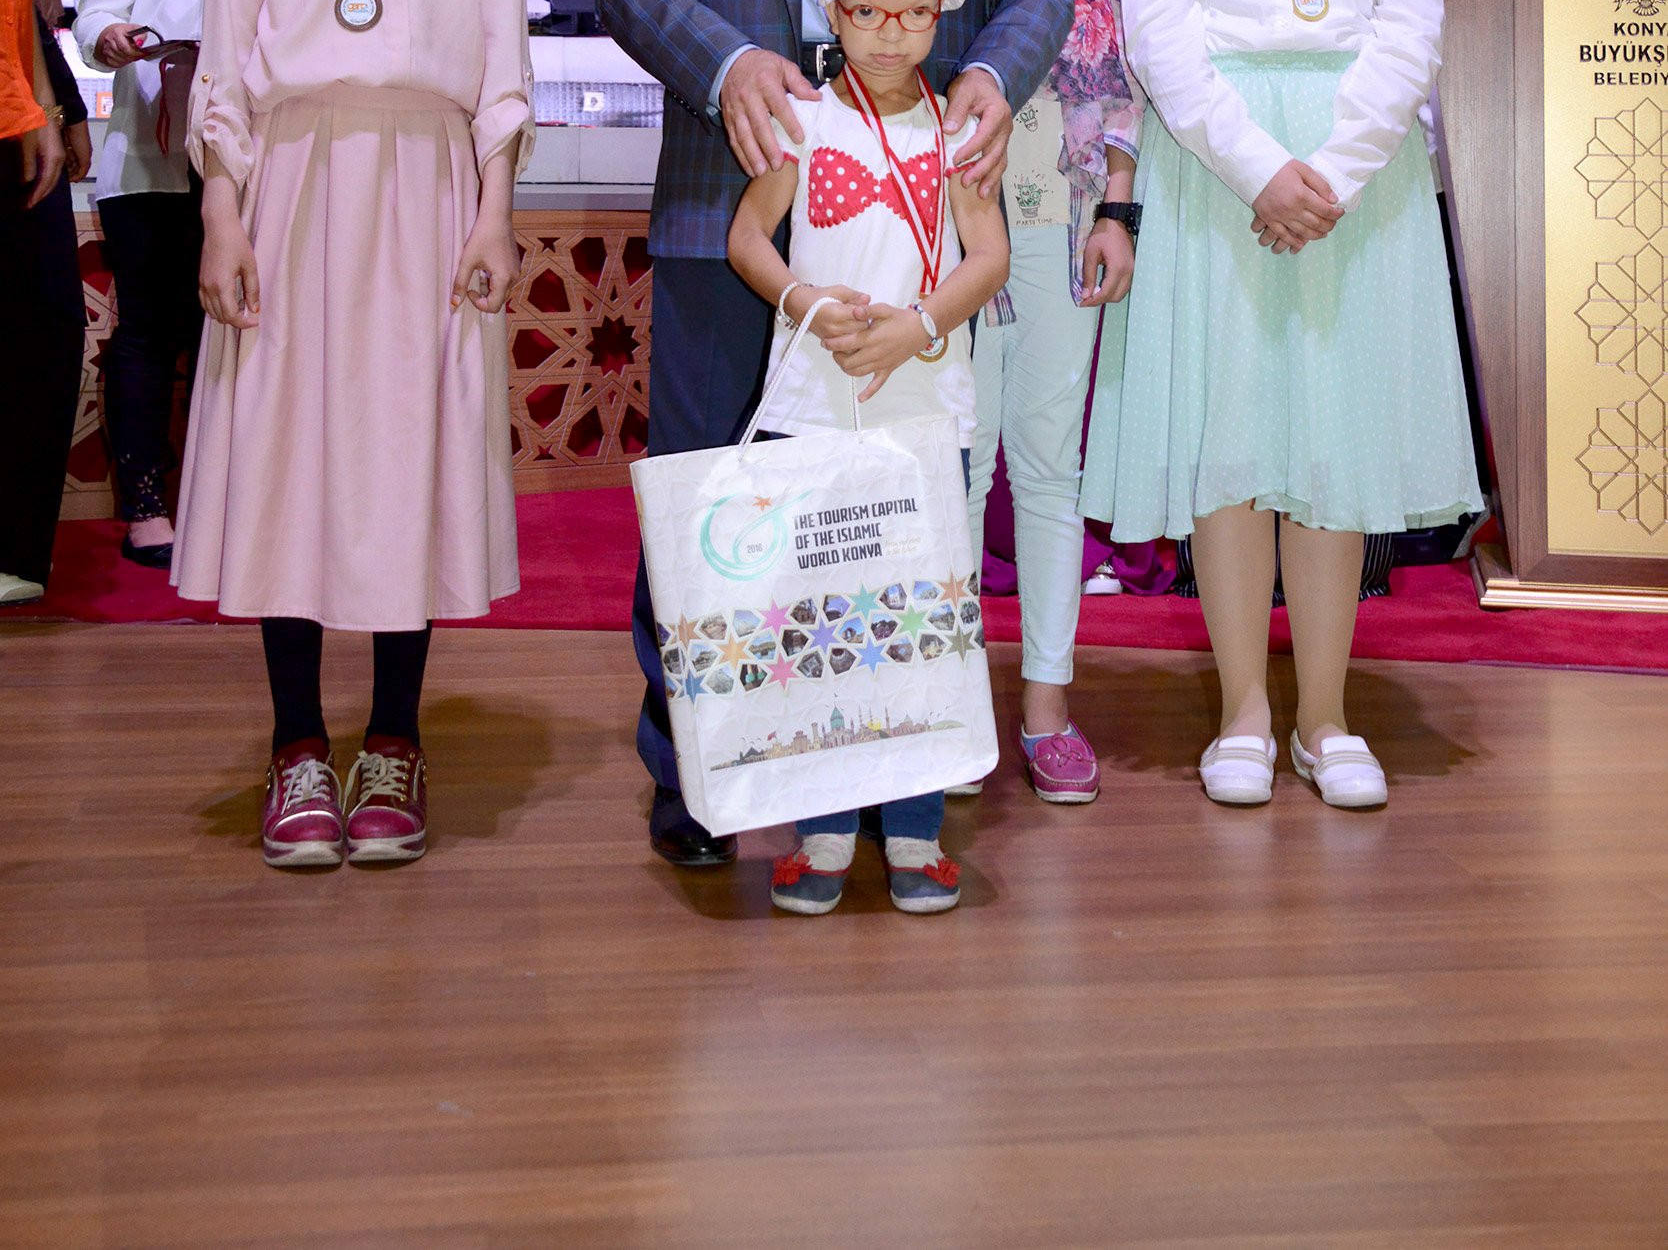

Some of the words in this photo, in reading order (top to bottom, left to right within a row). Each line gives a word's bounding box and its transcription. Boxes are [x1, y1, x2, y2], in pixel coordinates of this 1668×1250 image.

[1614, 22, 1668, 36] KONY
[1580, 41, 1668, 66] BÜYÜKŞ
[793, 514, 815, 530] THE
[817, 505, 869, 526] TOURISM
[872, 498, 918, 517] CAPITAL
[747, 544, 763, 554] 2016
[795, 534, 810, 550] OF
[812, 530, 835, 546] THE
[837, 523, 882, 543] ISLAMIC
[798, 550, 840, 569] WORLD
[842, 543, 882, 562] KONYA
